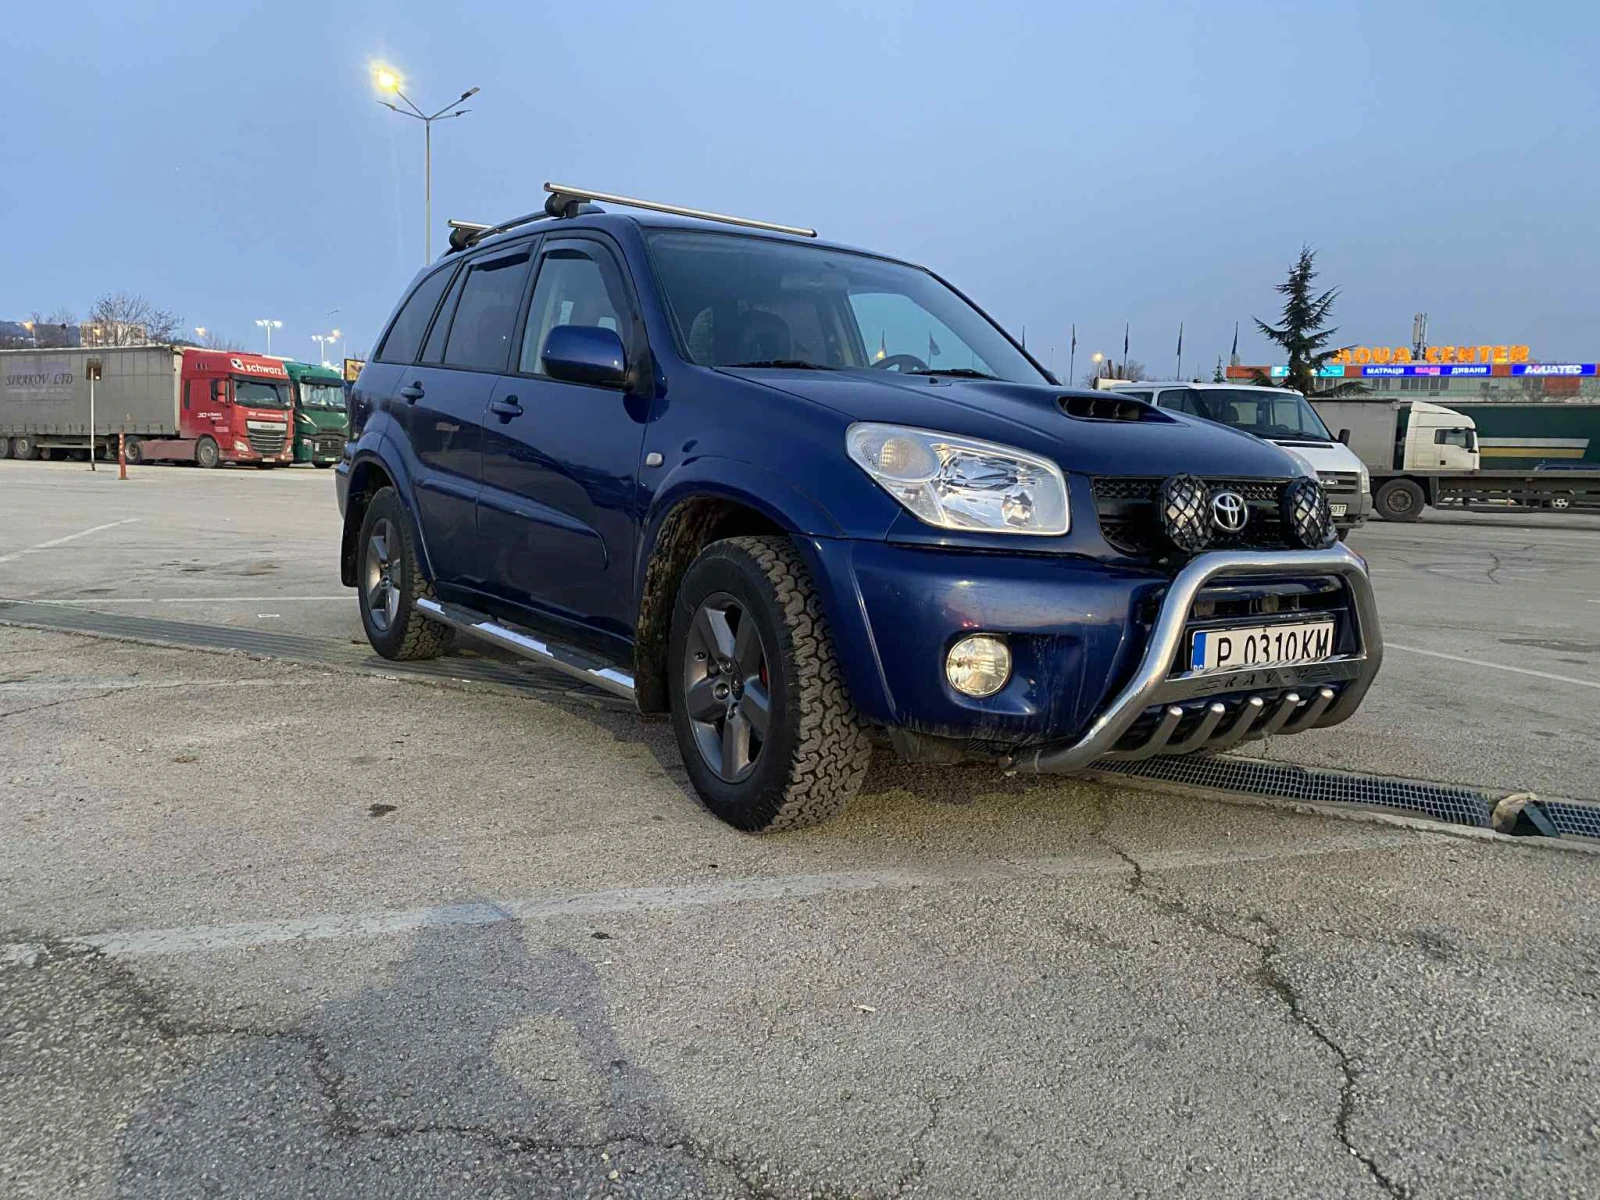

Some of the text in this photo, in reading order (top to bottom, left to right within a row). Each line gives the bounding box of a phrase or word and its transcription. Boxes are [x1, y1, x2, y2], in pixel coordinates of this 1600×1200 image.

[1331, 346, 1529, 363] AQUA CENTER
[246, 363, 283, 376] schwarz
[1366, 367, 1487, 375] МАТРАЦИ ДИВАНИ
[1524, 365, 1583, 375] AQUATEC
[53, 373, 73, 385] LTD
[1217, 637, 1232, 667] P
